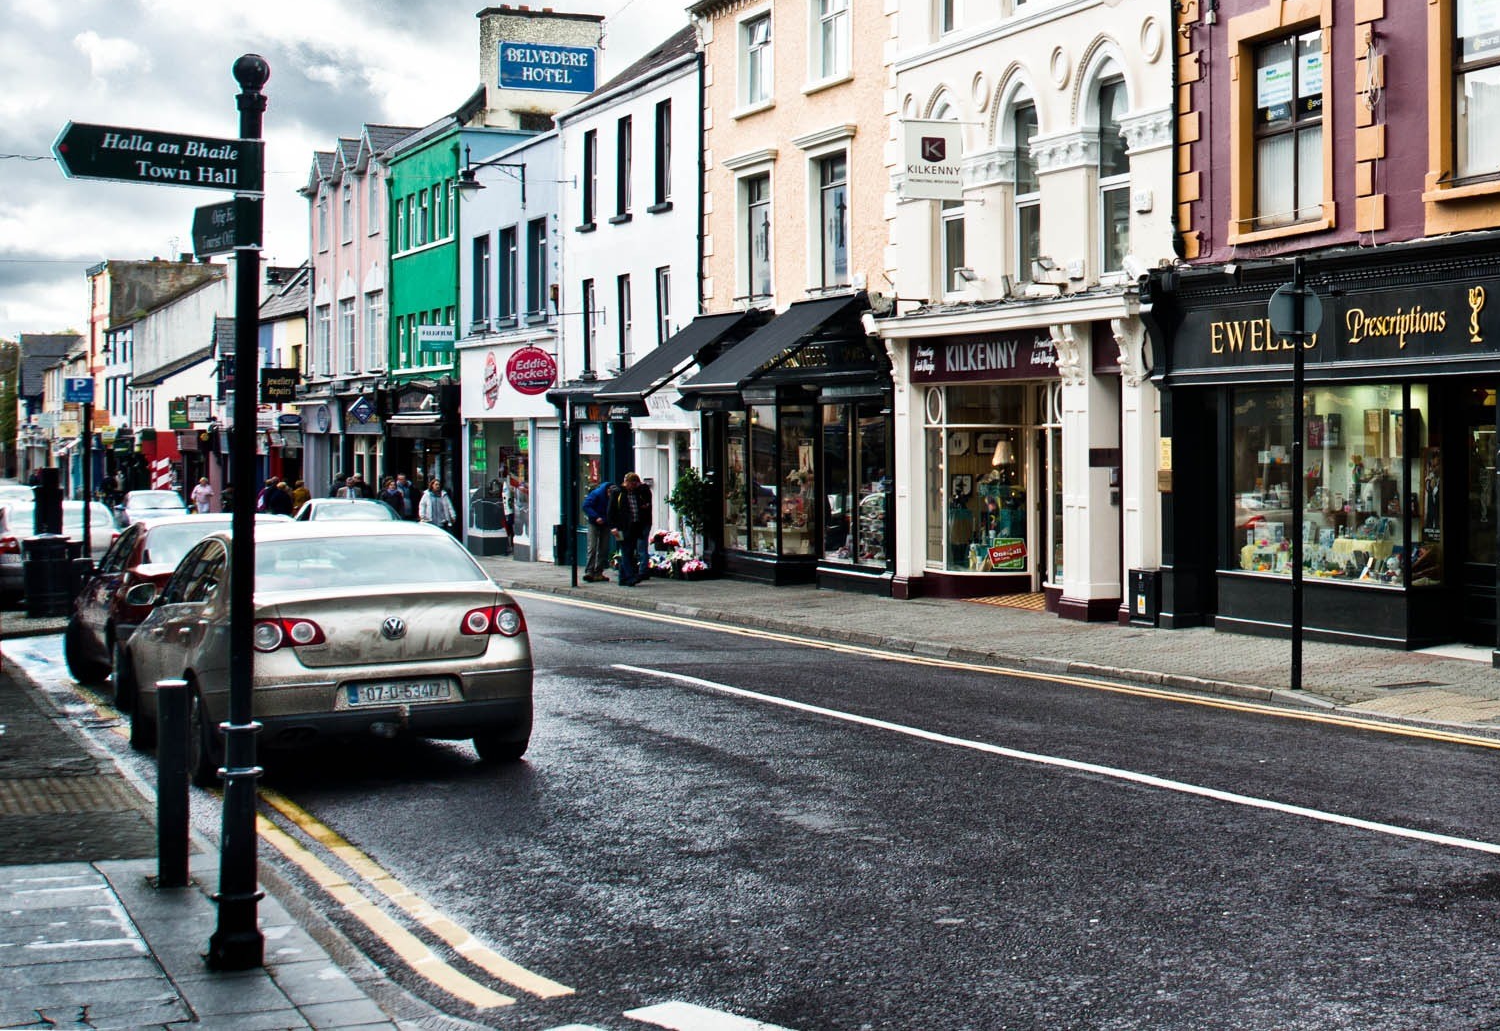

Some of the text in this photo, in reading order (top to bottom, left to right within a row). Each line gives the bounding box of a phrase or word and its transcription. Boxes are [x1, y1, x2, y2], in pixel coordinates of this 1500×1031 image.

[507, 48, 588, 67] BELVEDERE
[522, 67, 572, 83] HOTEL
[102, 133, 238, 160] Halla an Bhaile
[136, 160, 237, 184] Town Hall
[907, 164, 960, 176] KILKENNY
[1346, 306, 1446, 349] Prescriptions
[946, 340, 1019, 372] KILKENNY
[515, 358, 547, 370] Eddie
[509, 366, 555, 381] Rocket's
[73, 379, 86, 391] P
[267, 377, 294, 387] Jewellery
[269, 387, 291, 397] Repairs
